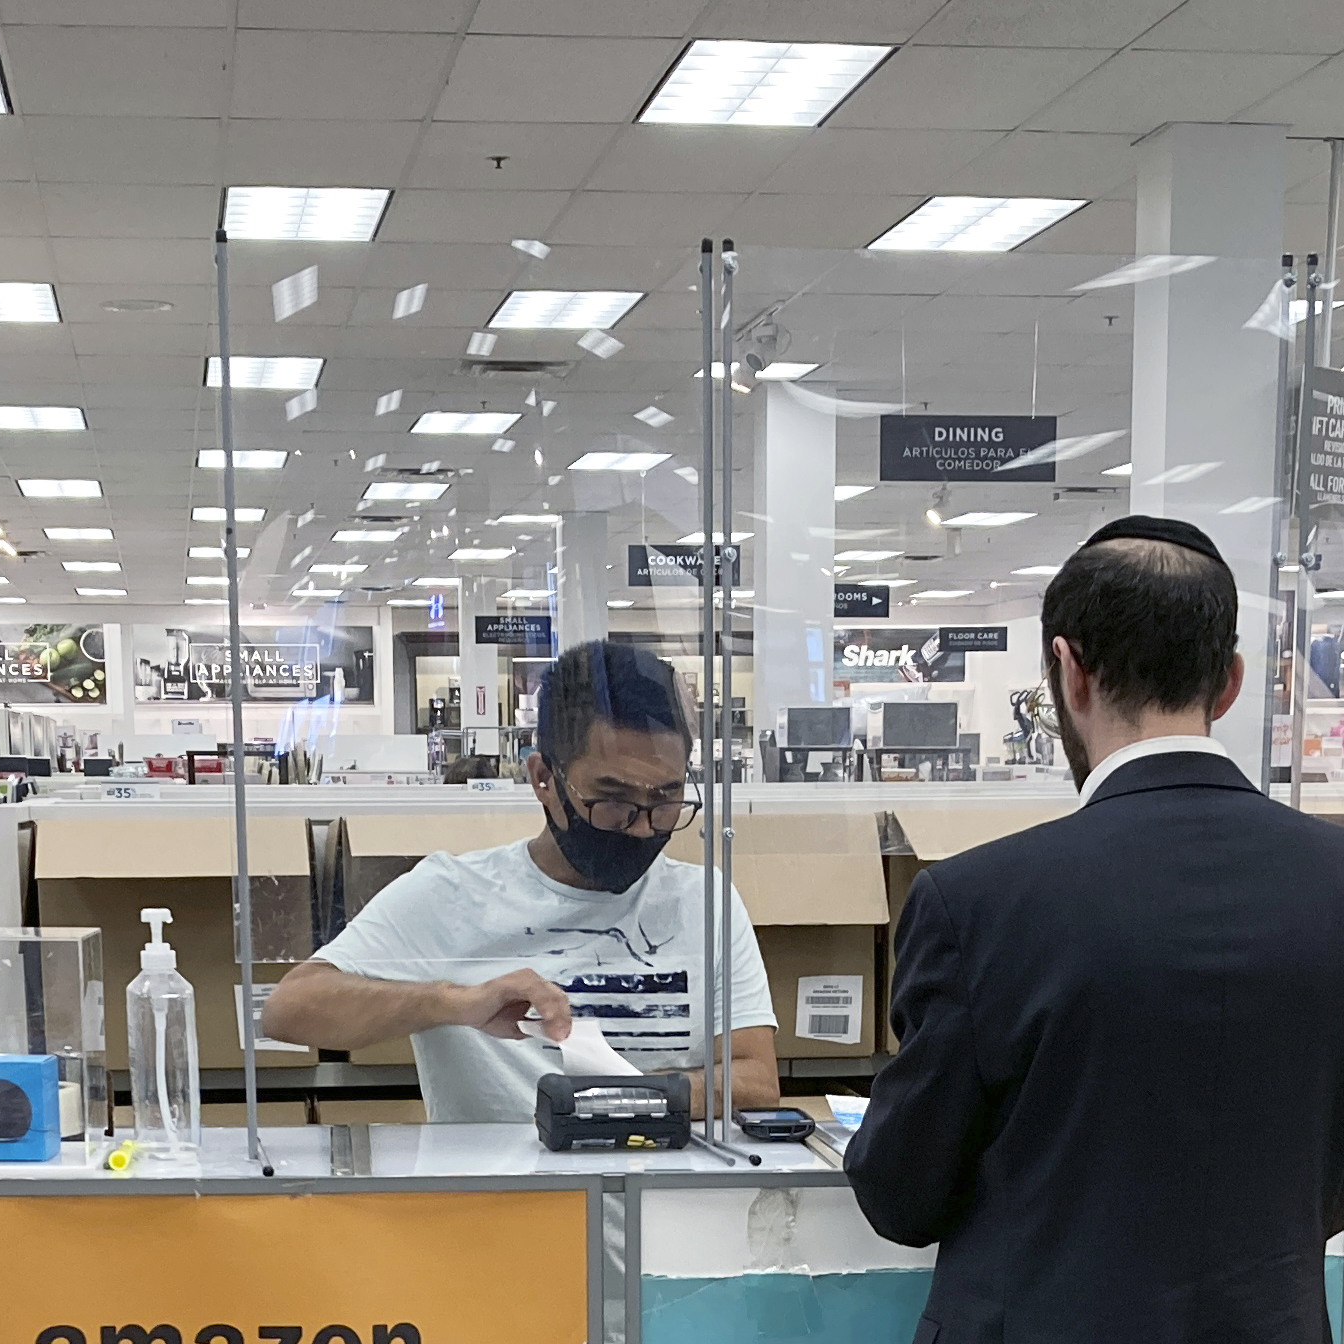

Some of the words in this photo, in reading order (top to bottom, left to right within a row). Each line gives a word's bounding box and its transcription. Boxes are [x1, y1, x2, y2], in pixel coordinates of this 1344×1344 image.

[1312, 416, 1328, 437] IFT
[934, 427, 1004, 442] DINING
[902, 446, 976, 458] ARTÍCULOS
[980, 448, 1014, 458] PARA
[936, 459, 1001, 471] COMEDOR
[1327, 475, 1344, 494] FOR
[648, 555, 721, 566] COOKWAE
[948, 632, 975, 640] FLOOR
[977, 632, 999, 640] CARE
[842, 644, 917, 667] Shark
[198, 664, 313, 677] APPIANCES
